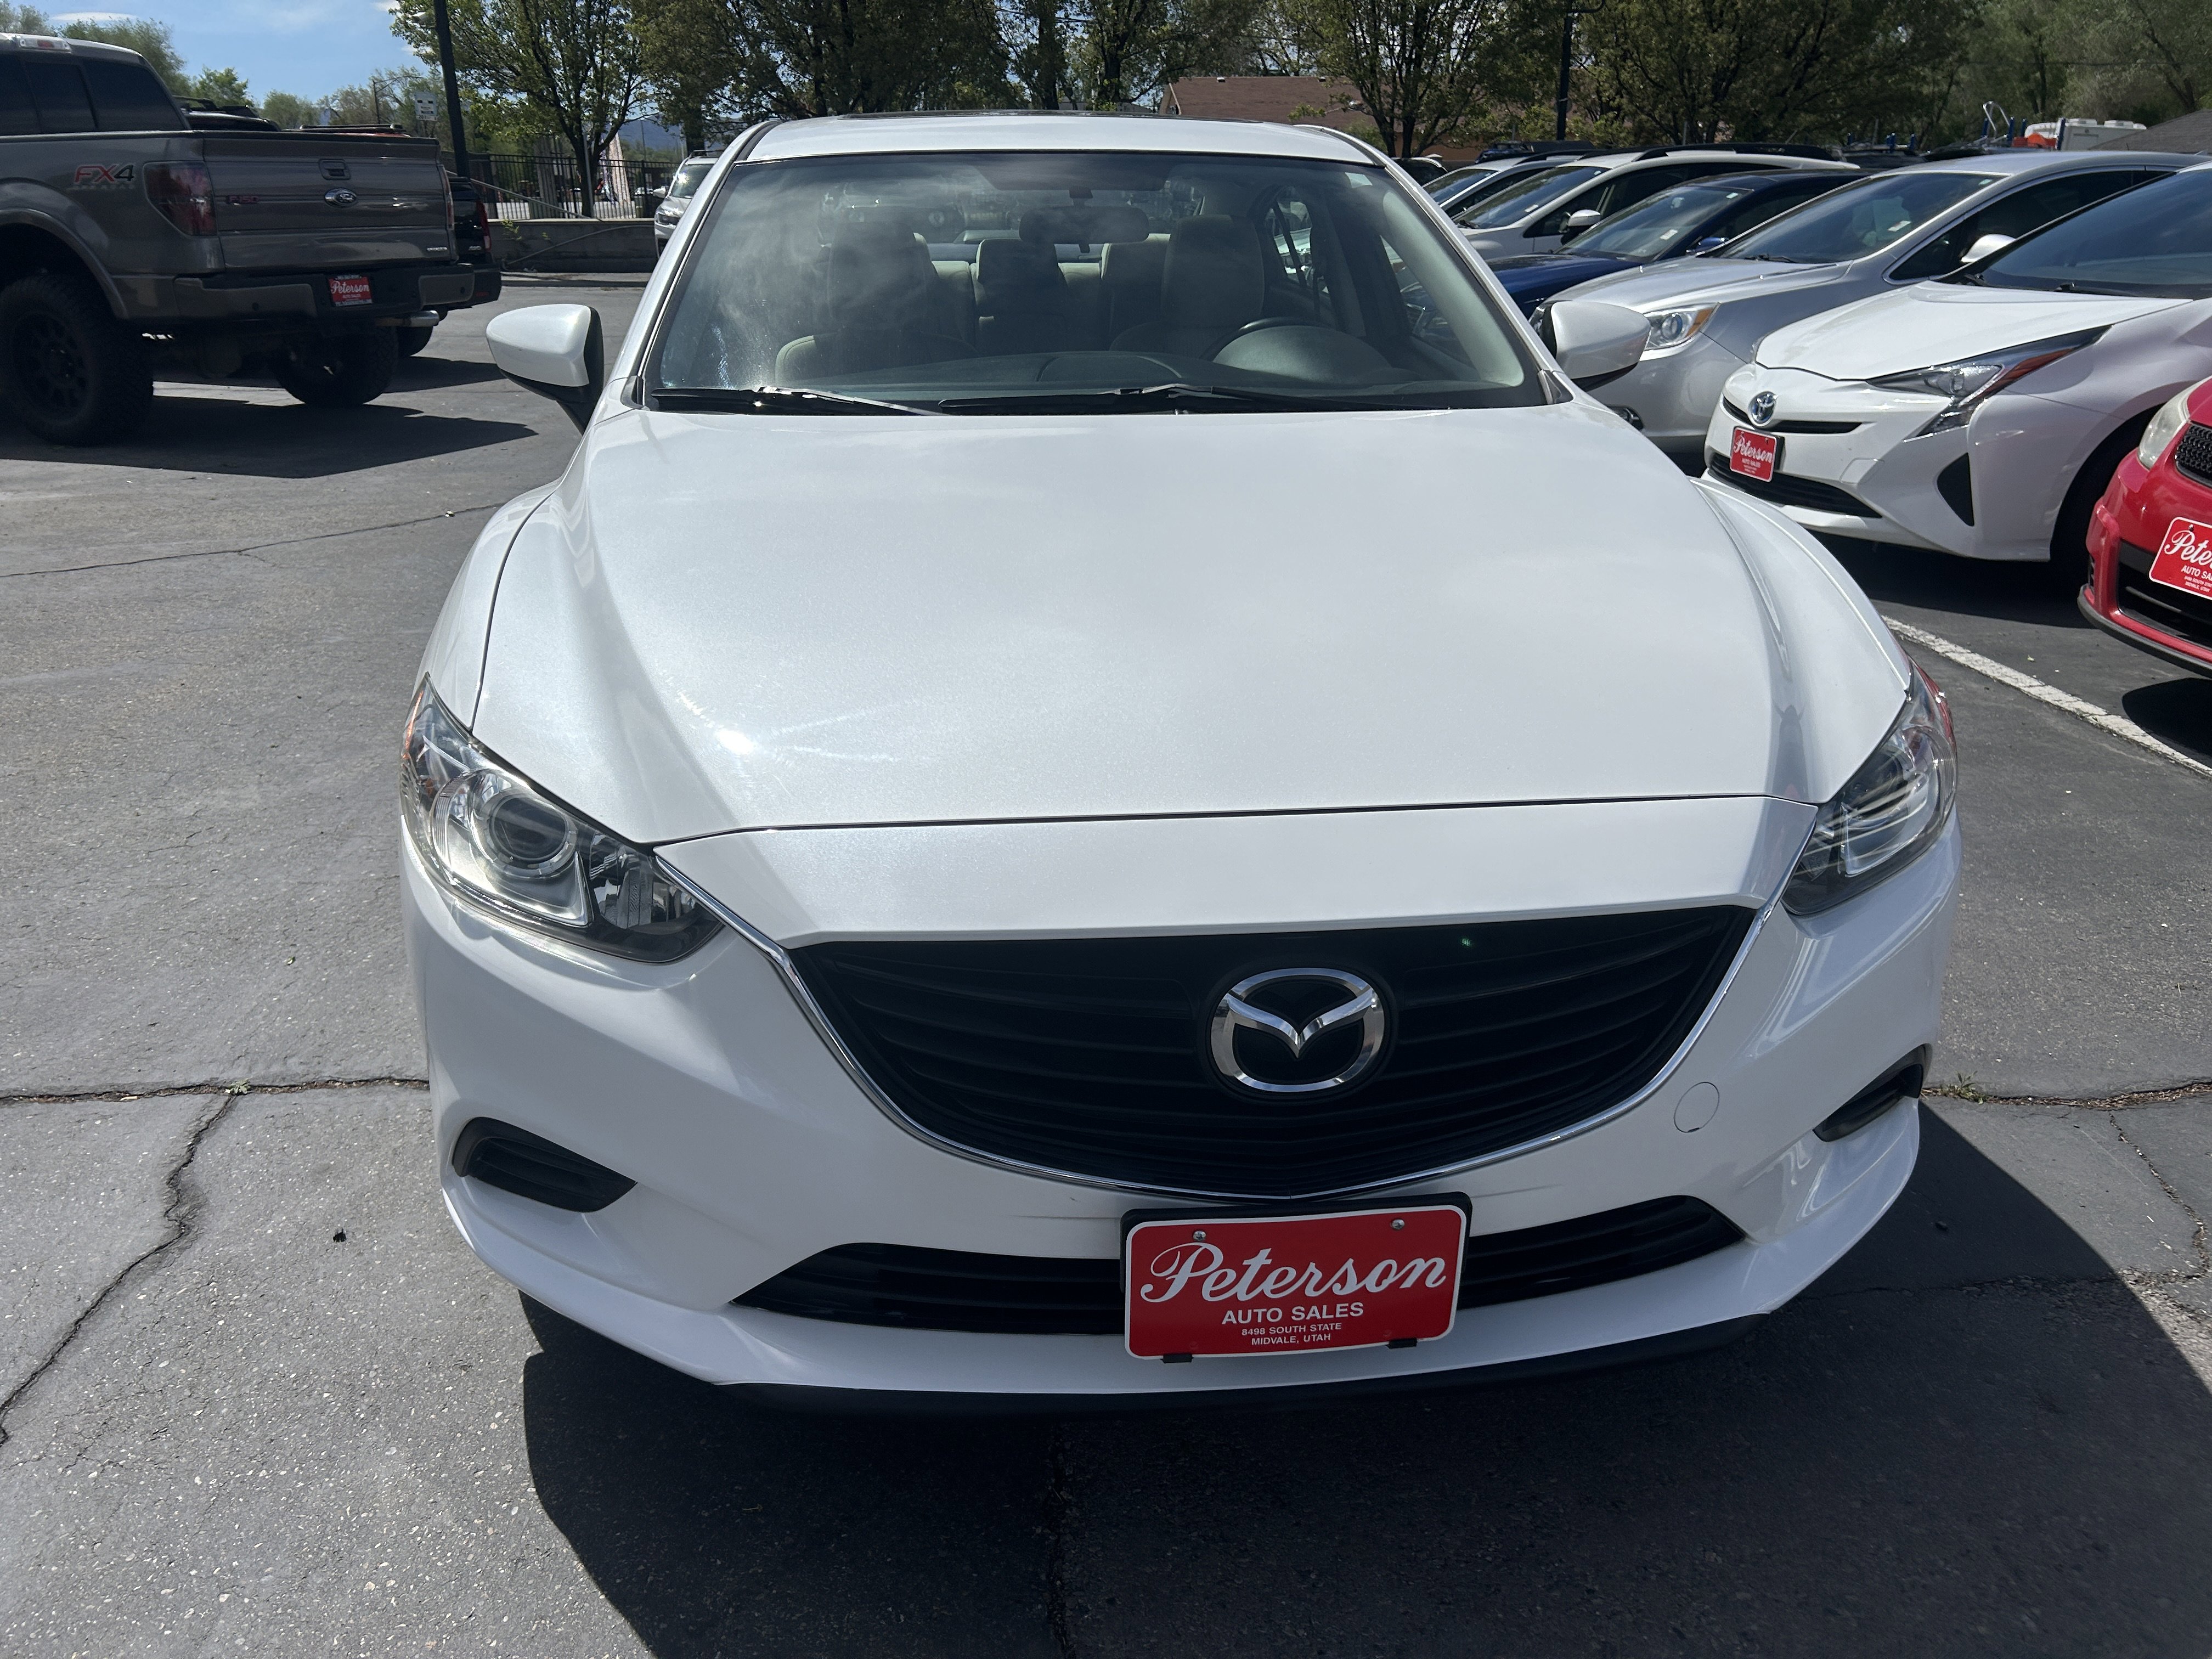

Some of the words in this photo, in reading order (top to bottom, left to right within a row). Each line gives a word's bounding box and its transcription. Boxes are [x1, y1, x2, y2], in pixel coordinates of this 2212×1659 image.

[74, 164, 134, 183] FX4
[330, 280, 370, 294] Peterson
[1734, 435, 1773, 464] Peterson
[2181, 565, 2200, 577] AUTO
[1141, 1243, 1446, 1303] Peterson
[1222, 1307, 1283, 1324] AUTO
[1291, 1302, 1363, 1321] SALES
[1242, 1327, 1266, 1335] 8498
[1269, 1325, 1306, 1334] SOUTH
[1310, 1322, 1342, 1331] STATE
[1251, 1335, 1299, 1345] MIDVALE,
[1304, 1333, 1331, 1342] UTAH
